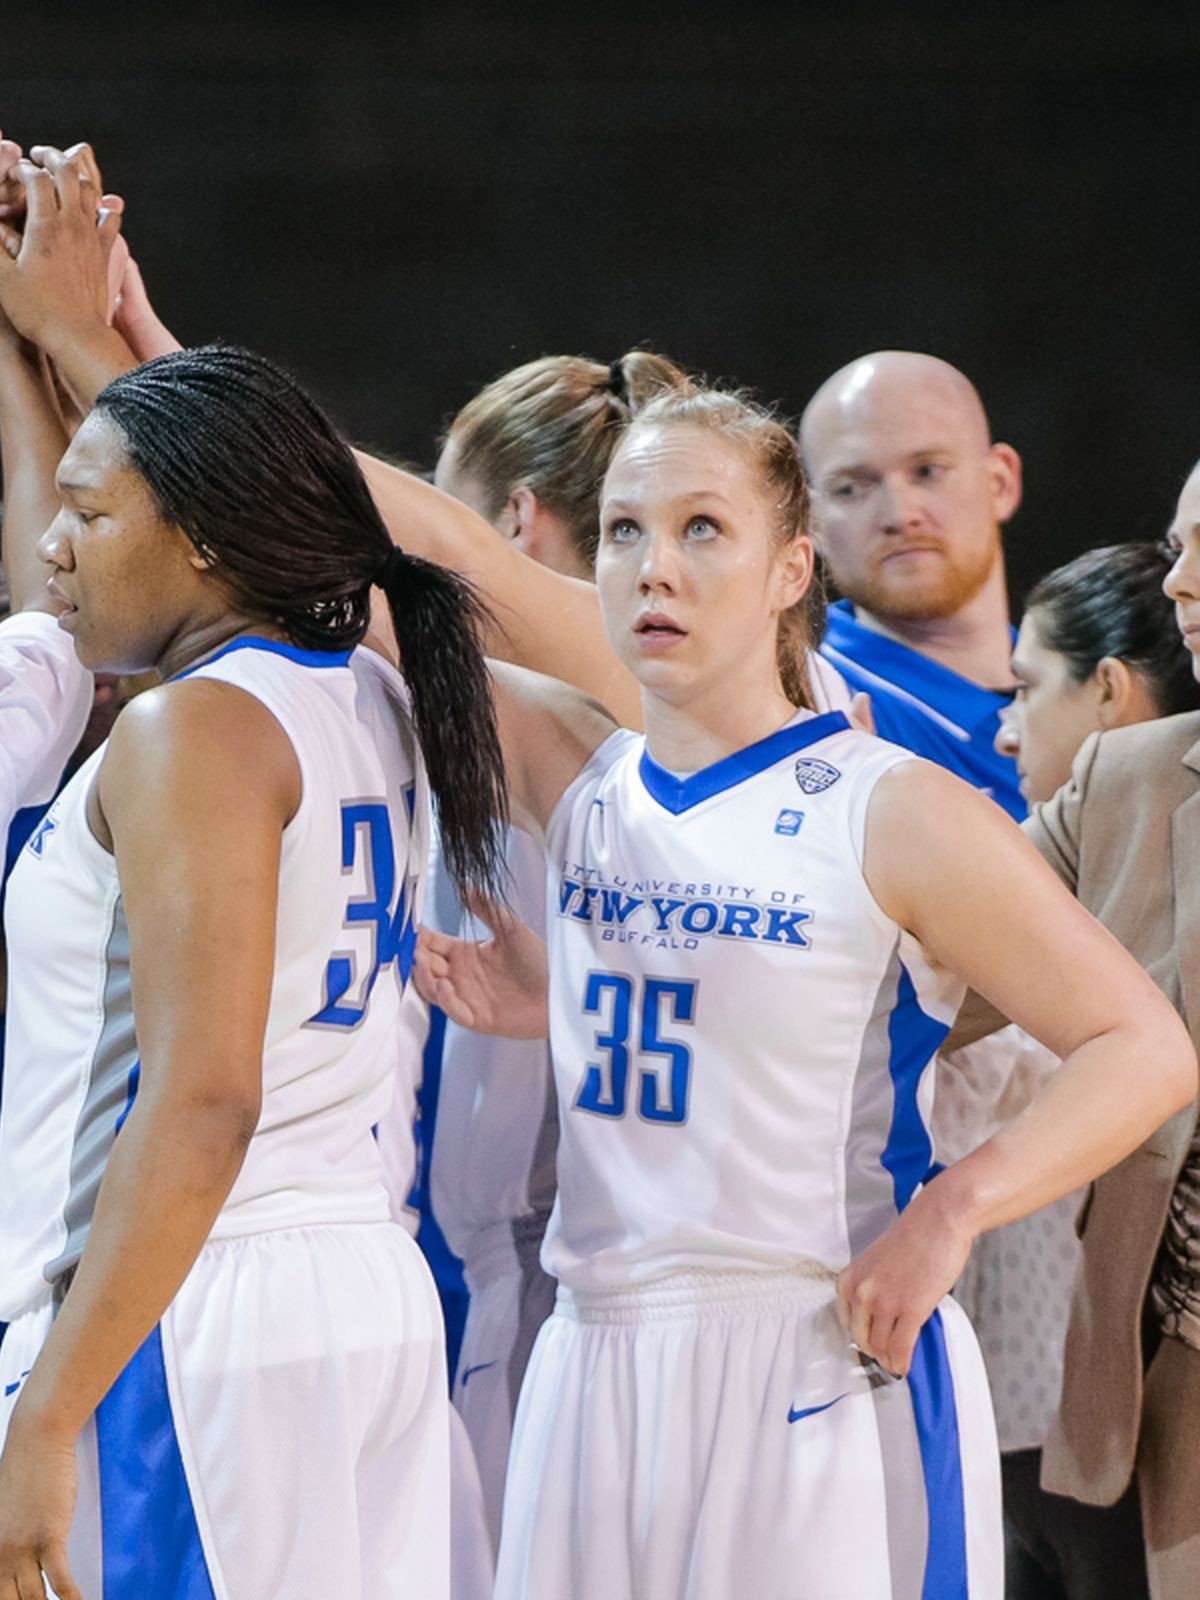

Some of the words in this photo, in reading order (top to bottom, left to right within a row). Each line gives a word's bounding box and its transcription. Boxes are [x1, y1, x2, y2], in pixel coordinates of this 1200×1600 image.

[613, 875, 755, 899] UNIVERSITY
[771, 890, 806, 905] OF
[601, 929, 699, 950] BUFFALO
[650, 898, 812, 947] YORK
[570, 968, 700, 1127] 35
